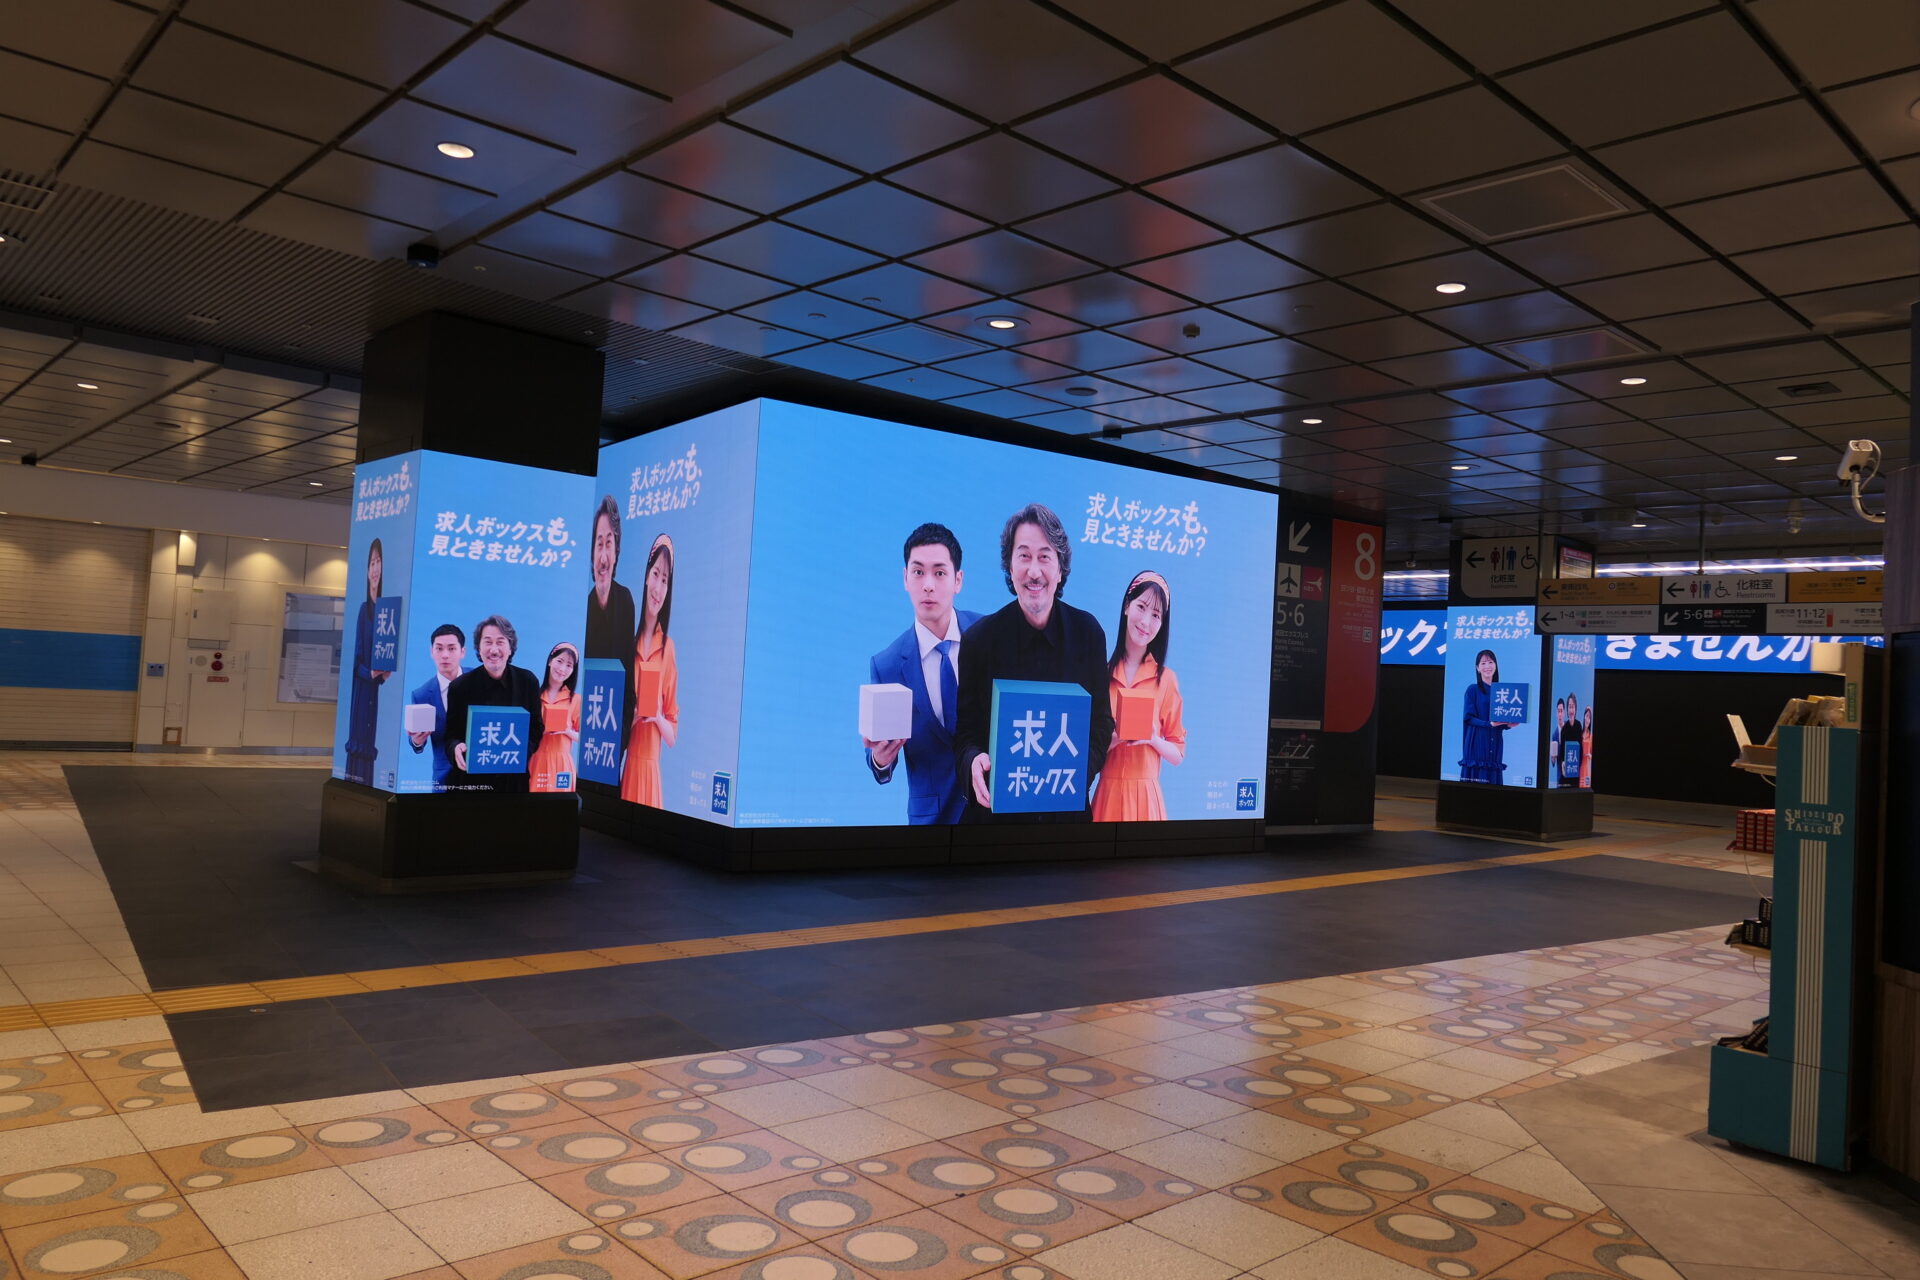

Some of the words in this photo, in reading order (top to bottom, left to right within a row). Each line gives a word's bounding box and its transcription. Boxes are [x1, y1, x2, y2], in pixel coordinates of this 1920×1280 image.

[358, 460, 413, 499] 求人ボックスも、
[630, 442, 703, 494] 求人ボックスも、
[355, 493, 411, 522] 見ときませんか？
[625, 481, 701, 521] 見ときませんか？
[1086, 492, 1208, 535] 求人ボックスも、
[434, 511, 577, 547] 求人ボックスも、
[1080, 518, 1207, 557] 見ときませんか？
[428, 534, 573, 568] 見ときませんか？
[1354, 532, 1376, 581] 8
[1736, 579, 1774, 591] 化粧室
[376, 607, 396, 637] 求人
[1453, 628, 1530, 640] 見ときませんか？
[1456, 610, 1533, 627] 求人ボックスも、
[374, 641, 395, 660] ボックス
[1380, 619, 1446, 657] ック
[586, 685, 618, 732] 求人
[1494, 688, 1523, 705] 求人
[1494, 706, 1522, 718] ボックス
[478, 721, 522, 746] 求人
[1009, 710, 1079, 758] 求人
[477, 749, 520, 766] ボックス
[584, 737, 616, 768] ボックス
[1007, 766, 1077, 797] ボックス
[1239, 786, 1254, 798] 求人
